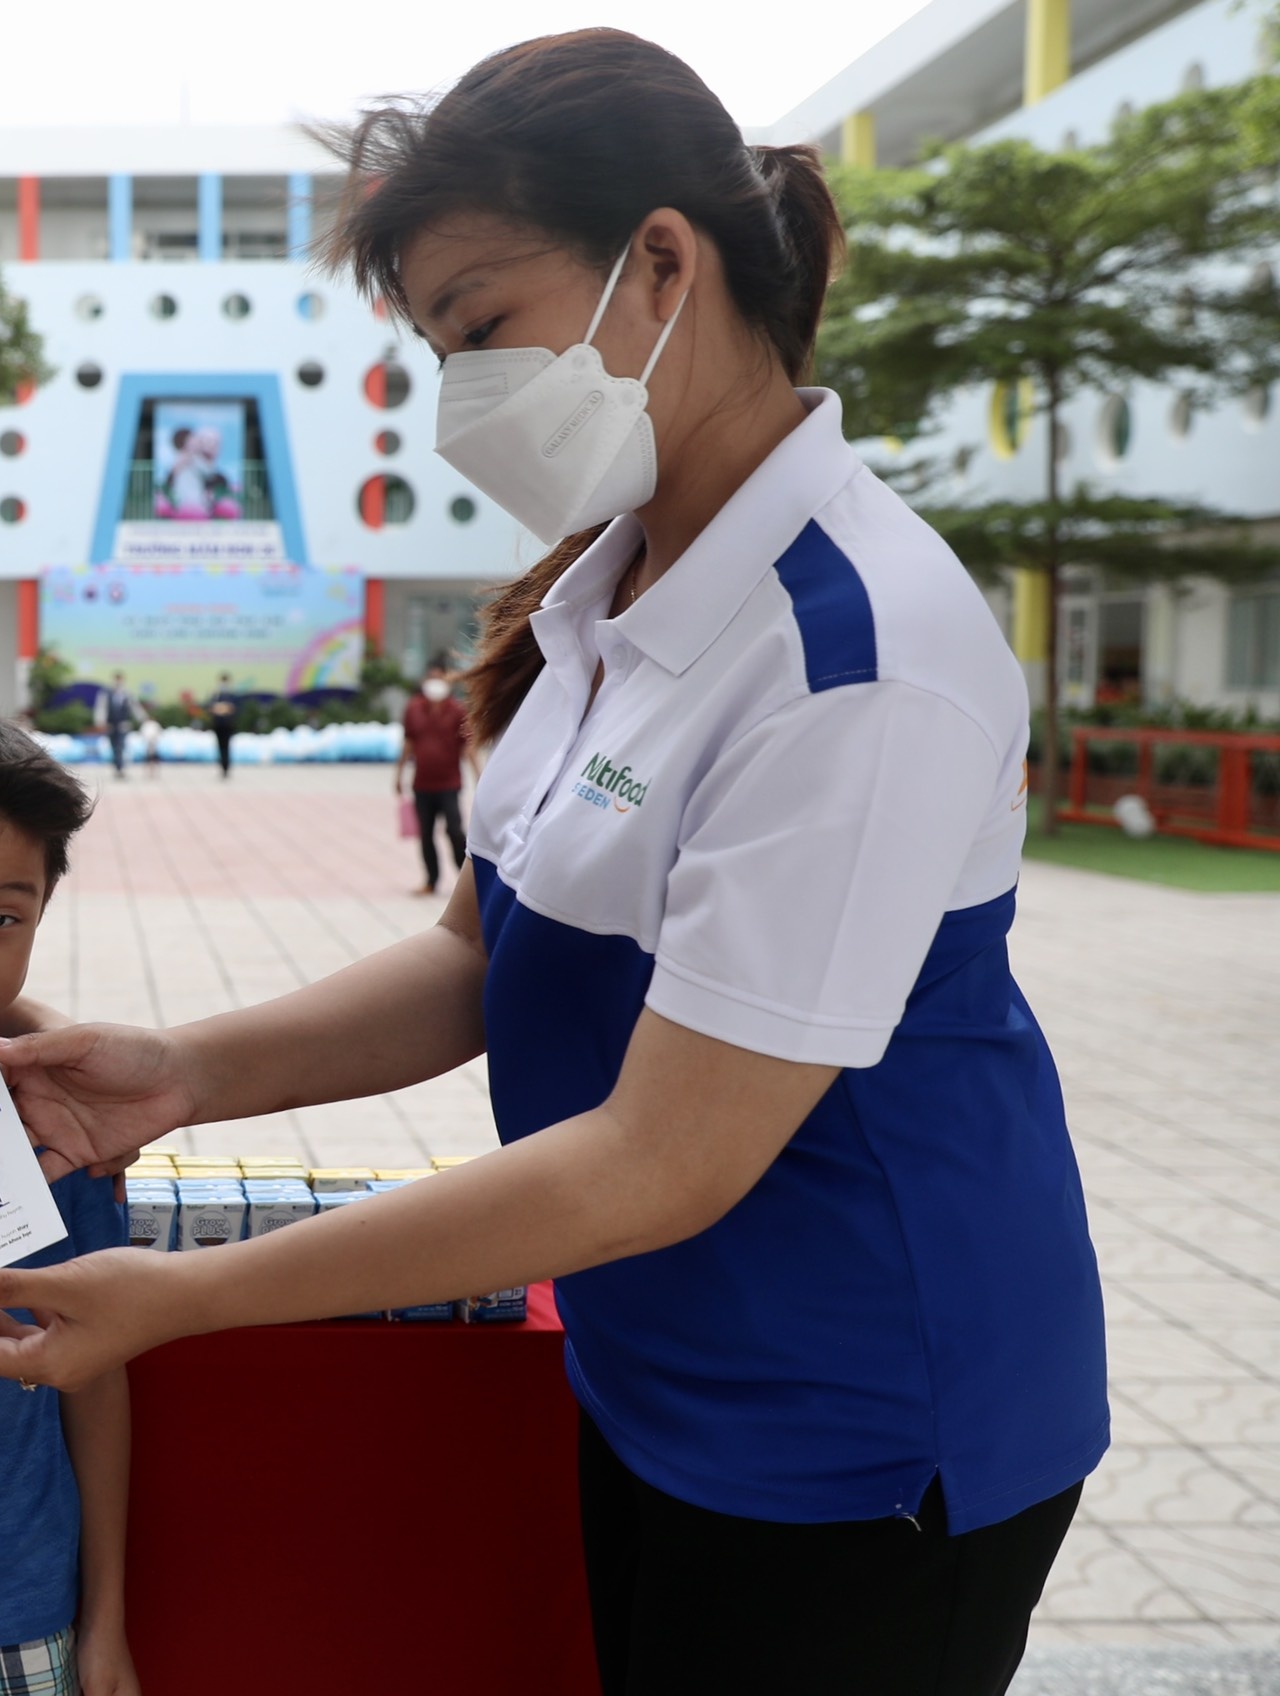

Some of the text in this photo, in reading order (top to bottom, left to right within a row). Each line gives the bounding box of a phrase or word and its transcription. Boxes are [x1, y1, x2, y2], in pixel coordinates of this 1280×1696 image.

[197, 1217, 225, 1226] Grow
[130, 1226, 159, 1236] LUS+
[193, 1226, 231, 1236] PLUS+
